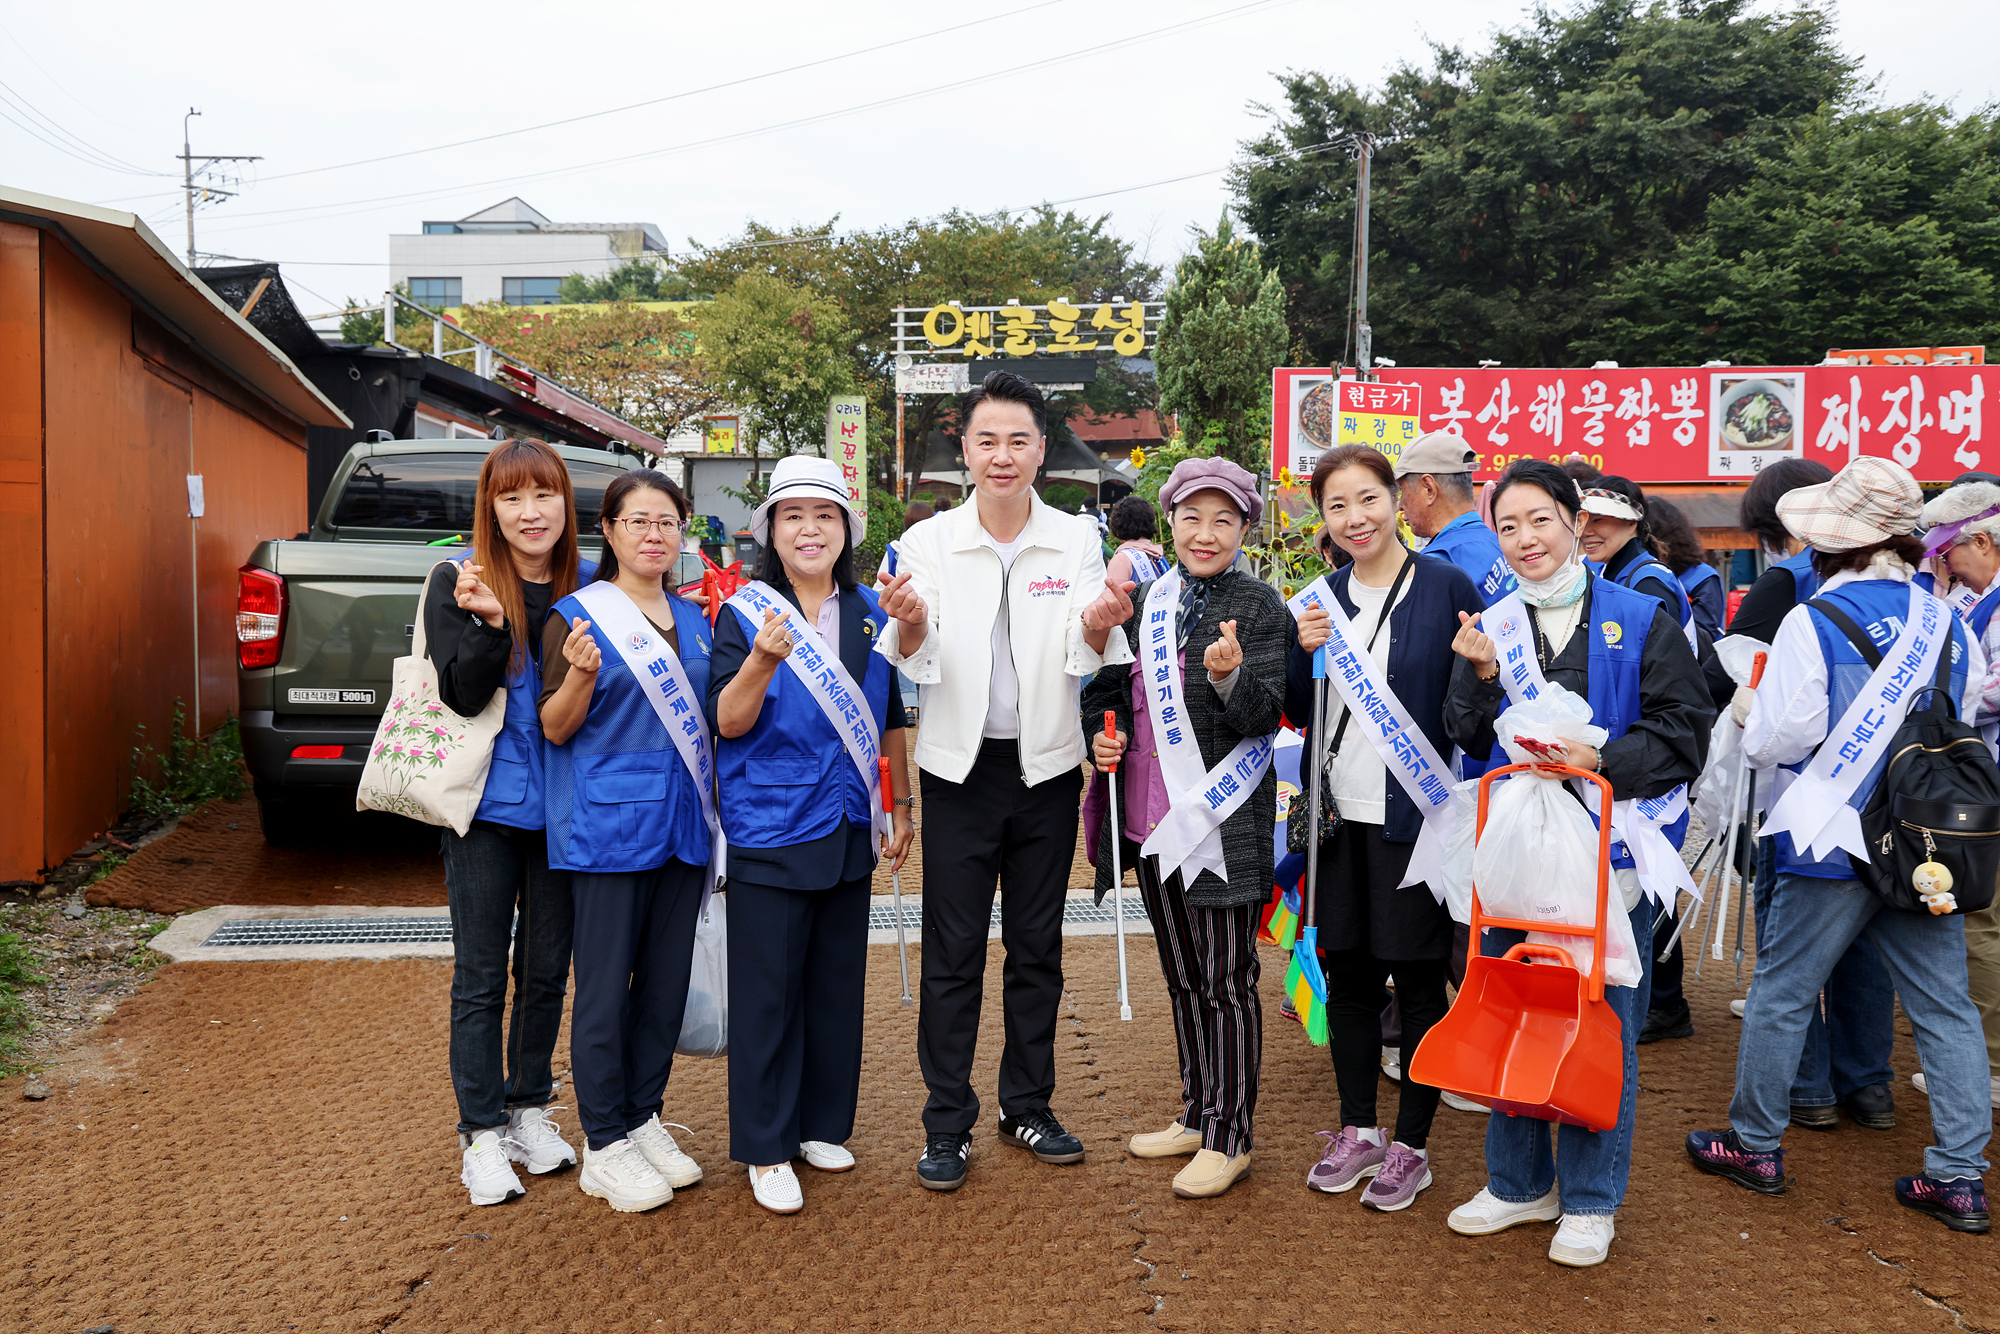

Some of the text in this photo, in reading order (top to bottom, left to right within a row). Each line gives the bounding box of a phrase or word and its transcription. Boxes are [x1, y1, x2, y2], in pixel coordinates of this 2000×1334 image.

[1347, 385, 1412, 412] 현금가
[1816, 374, 1985, 470] 짜장면
[292, 691, 372, 703] 최대적재량 500kg
[647, 656, 712, 794] 바르게살기운동
[816, 667, 861, 725] 기초질서
[850, 719, 877, 764] 지키기
[1151, 609, 1183, 746] 바르게살기운동
[1352, 677, 1401, 739] 기초질서
[1388, 731, 1431, 779] 지키기
